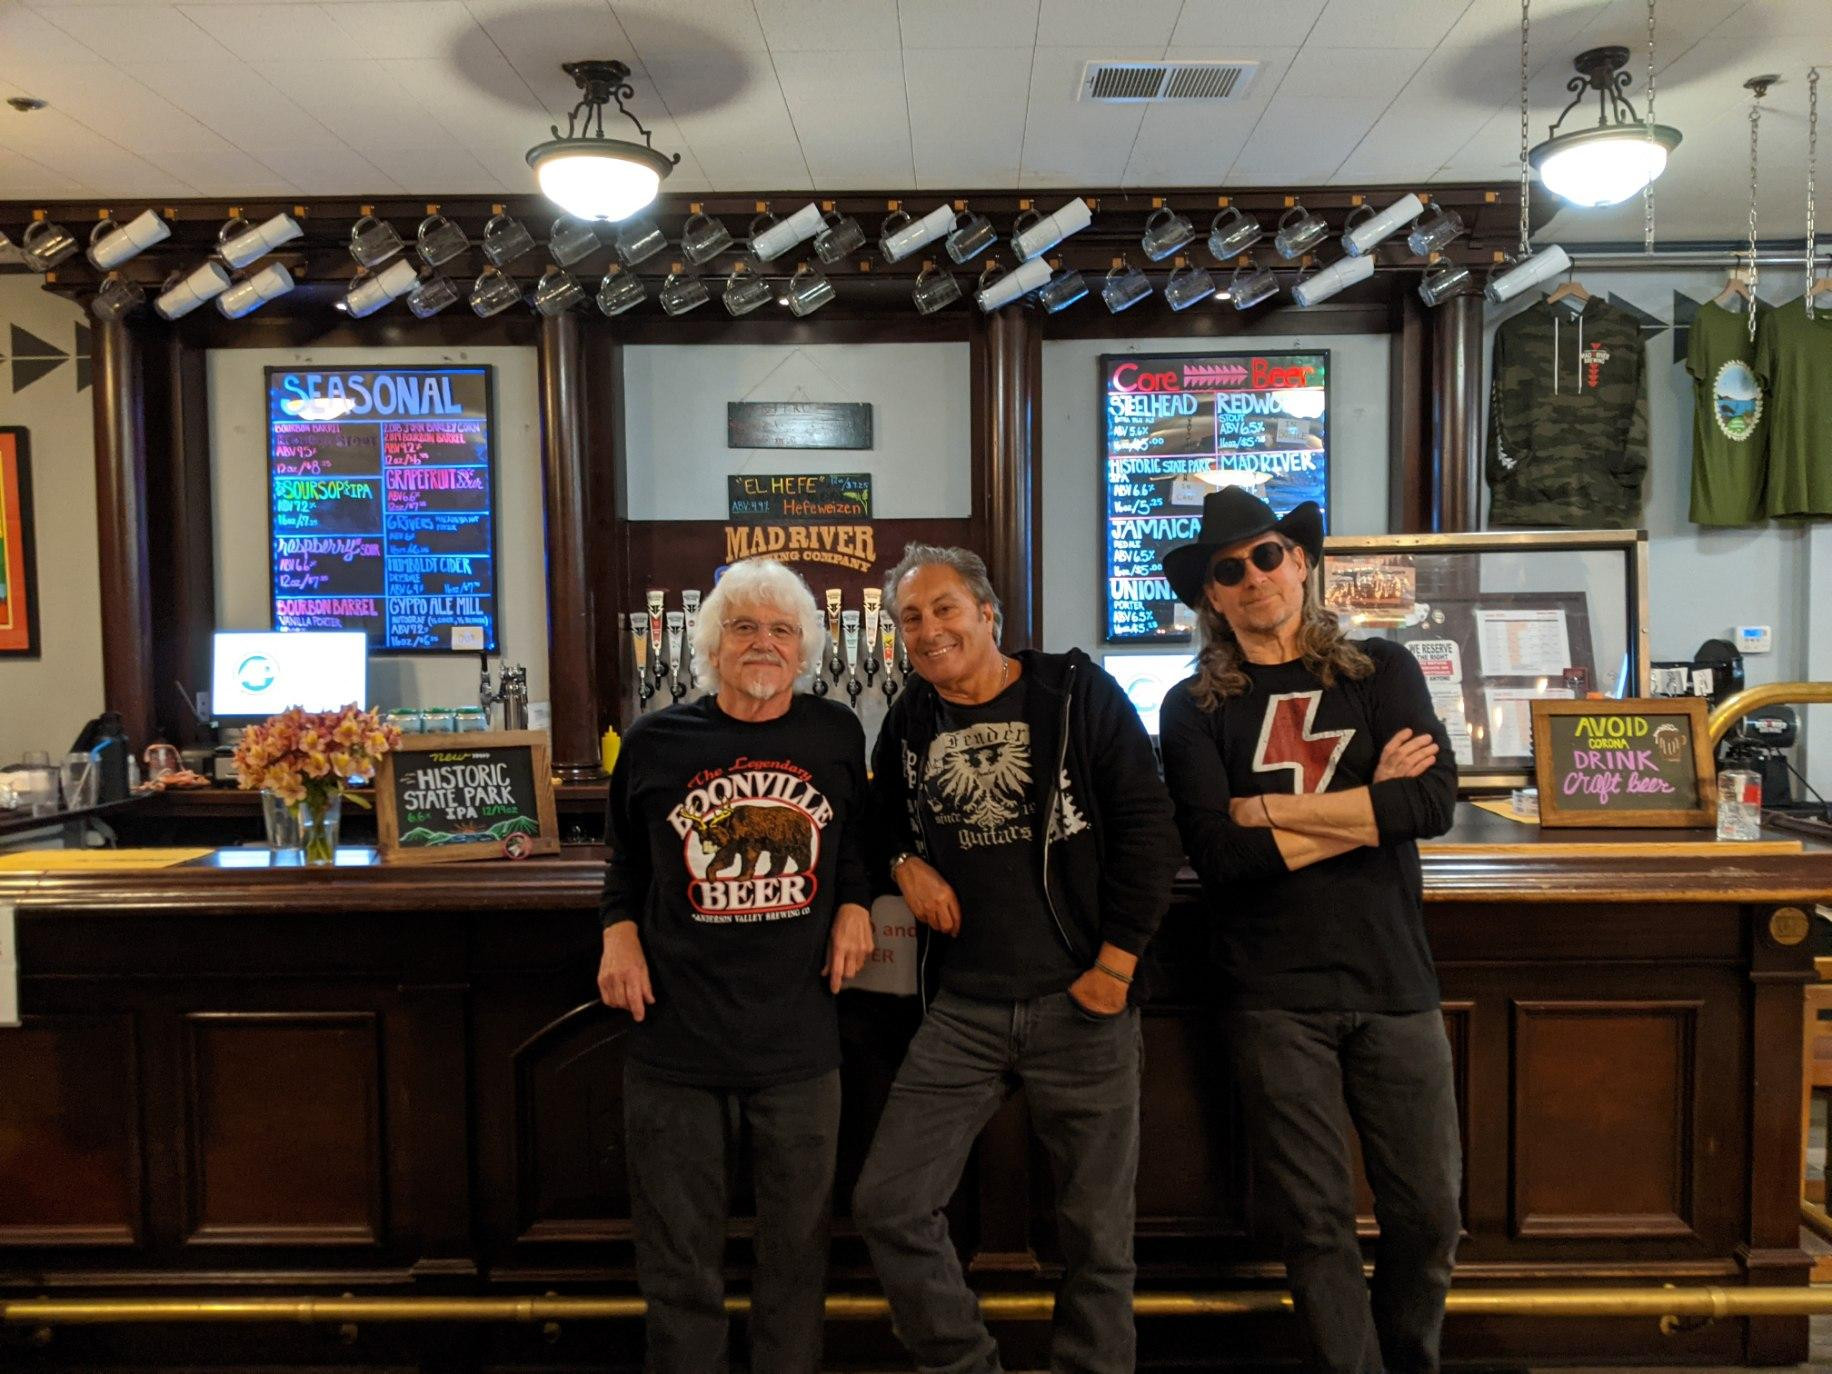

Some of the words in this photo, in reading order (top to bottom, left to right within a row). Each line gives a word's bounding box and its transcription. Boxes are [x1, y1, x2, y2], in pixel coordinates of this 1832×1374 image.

[1112, 362, 1180, 392] Core
[1252, 357, 1315, 389] Beer
[280, 375, 463, 416] SEASONAL
[1109, 393, 1198, 417] STEELHEAD
[1217, 392, 1284, 415] REDWO
[1219, 414, 1245, 423] STOUT
[1219, 422, 1239, 435] ABV
[1109, 459, 1161, 474] HISTORIC
[1162, 460, 1188, 473] STATE
[1188, 459, 1210, 473] PARK
[1220, 454, 1259, 472] MAD
[1260, 451, 1317, 472] RIVER
[386, 469, 456, 490] GRAPEFRUIT
[783, 499, 861, 516] Hefeweizen
[278, 538, 360, 561] raspberry
[725, 526, 786, 564] MAD
[789, 526, 876, 564] RIVER
[387, 557, 438, 573] HUMBOLDT
[439, 557, 472, 575] CIDER
[802, 552, 872, 573] COMPANY
[1111, 580, 1179, 601] UNION
[277, 599, 332, 615] BOURBON
[332, 599, 379, 616] BARREL
[389, 597, 427, 614] GYPPO
[429, 597, 453, 615] ALE
[456, 597, 484, 615] MILL
[1113, 601, 1145, 611] PORTER
[279, 616, 312, 627] VANILLA
[1421, 643, 1453, 654] RESERVE
[944, 726, 1027, 748] Fender
[1574, 716, 1649, 737] AVOID
[1588, 738, 1630, 750] CORONA
[1574, 750, 1660, 771] DRINK
[416, 763, 511, 790] HISTORIC
[687, 768, 724, 788] The
[728, 757, 814, 782] Legendary
[403, 788, 458, 811] STATE
[463, 786, 516, 809] PARK
[666, 771, 834, 840] BOONVILLE
[445, 807, 479, 820] IPA
[700, 875, 808, 911] BEER
[734, 913, 763, 923] VALLEY
[765, 909, 800, 921] BREWING
